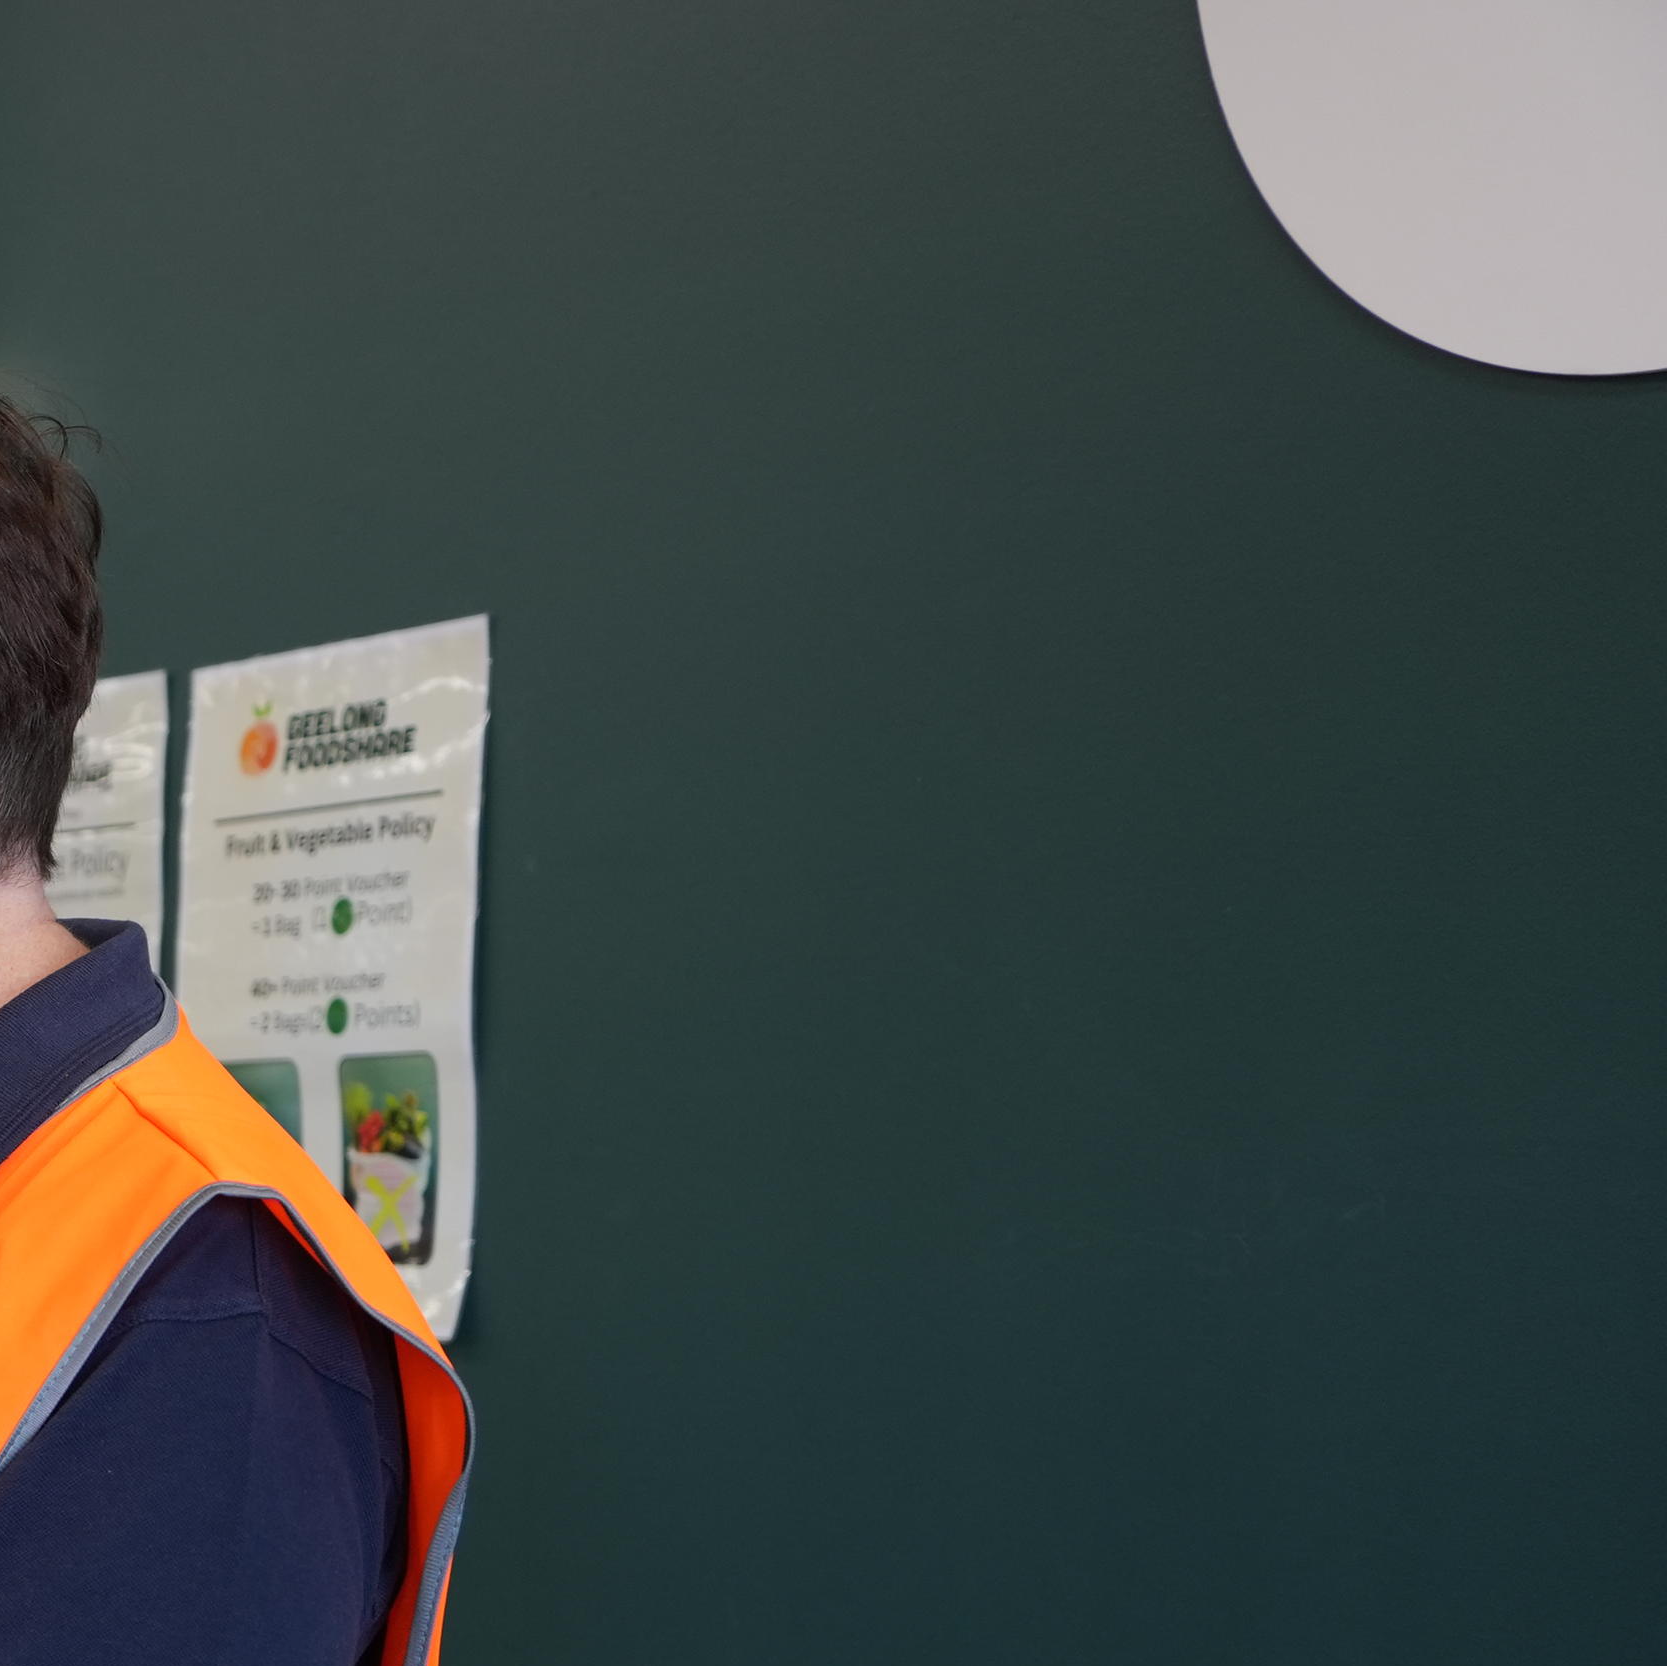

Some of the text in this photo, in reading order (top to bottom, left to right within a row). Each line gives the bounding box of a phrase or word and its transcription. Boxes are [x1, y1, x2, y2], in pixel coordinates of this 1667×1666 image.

[287, 698, 386, 741] GEELONG
[283, 725, 416, 774] FOODSHARE
[225, 811, 436, 857] Fruit & Vegetable Policy
[345, 869, 410, 893] Voucher
[324, 971, 385, 993] Voucher
